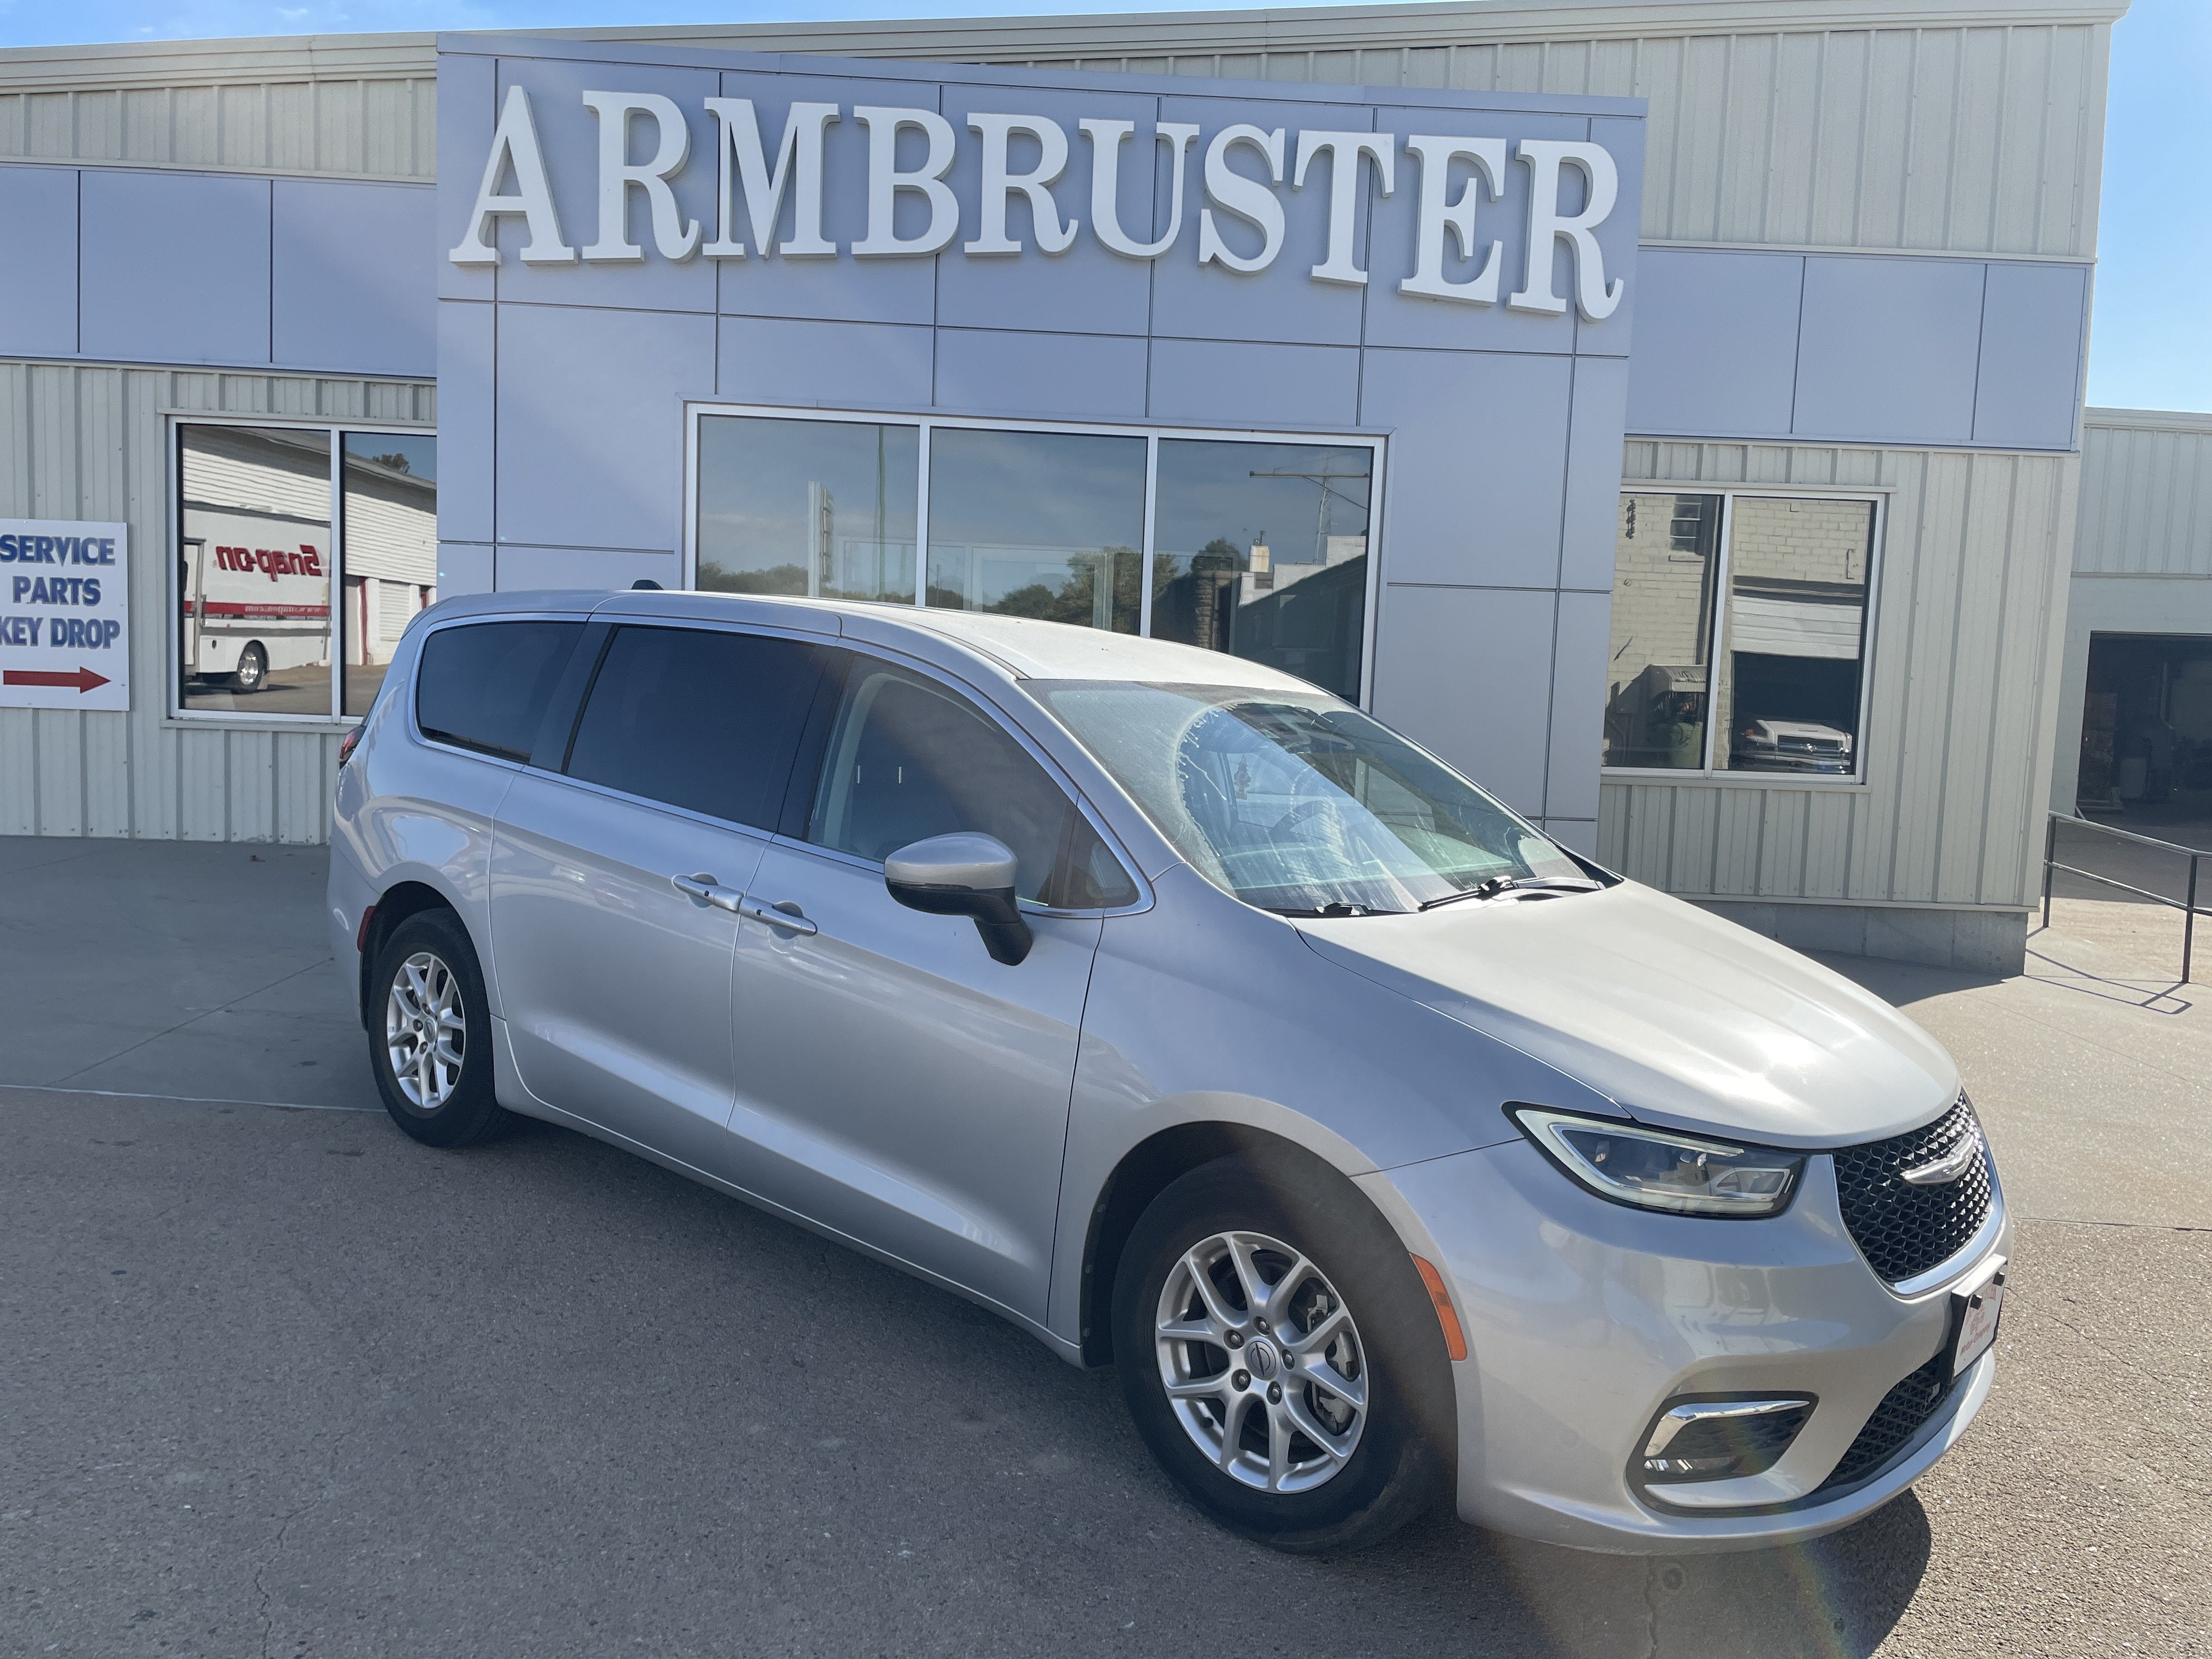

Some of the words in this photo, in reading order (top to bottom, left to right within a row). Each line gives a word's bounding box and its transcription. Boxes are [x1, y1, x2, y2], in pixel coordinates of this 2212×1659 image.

[449, 83, 1624, 322] ARMBRUSTER
[0, 534, 115, 567] SERVICE
[13, 576, 101, 607] PARTS
[0, 616, 44, 646] KEY
[50, 618, 120, 650] DROP
